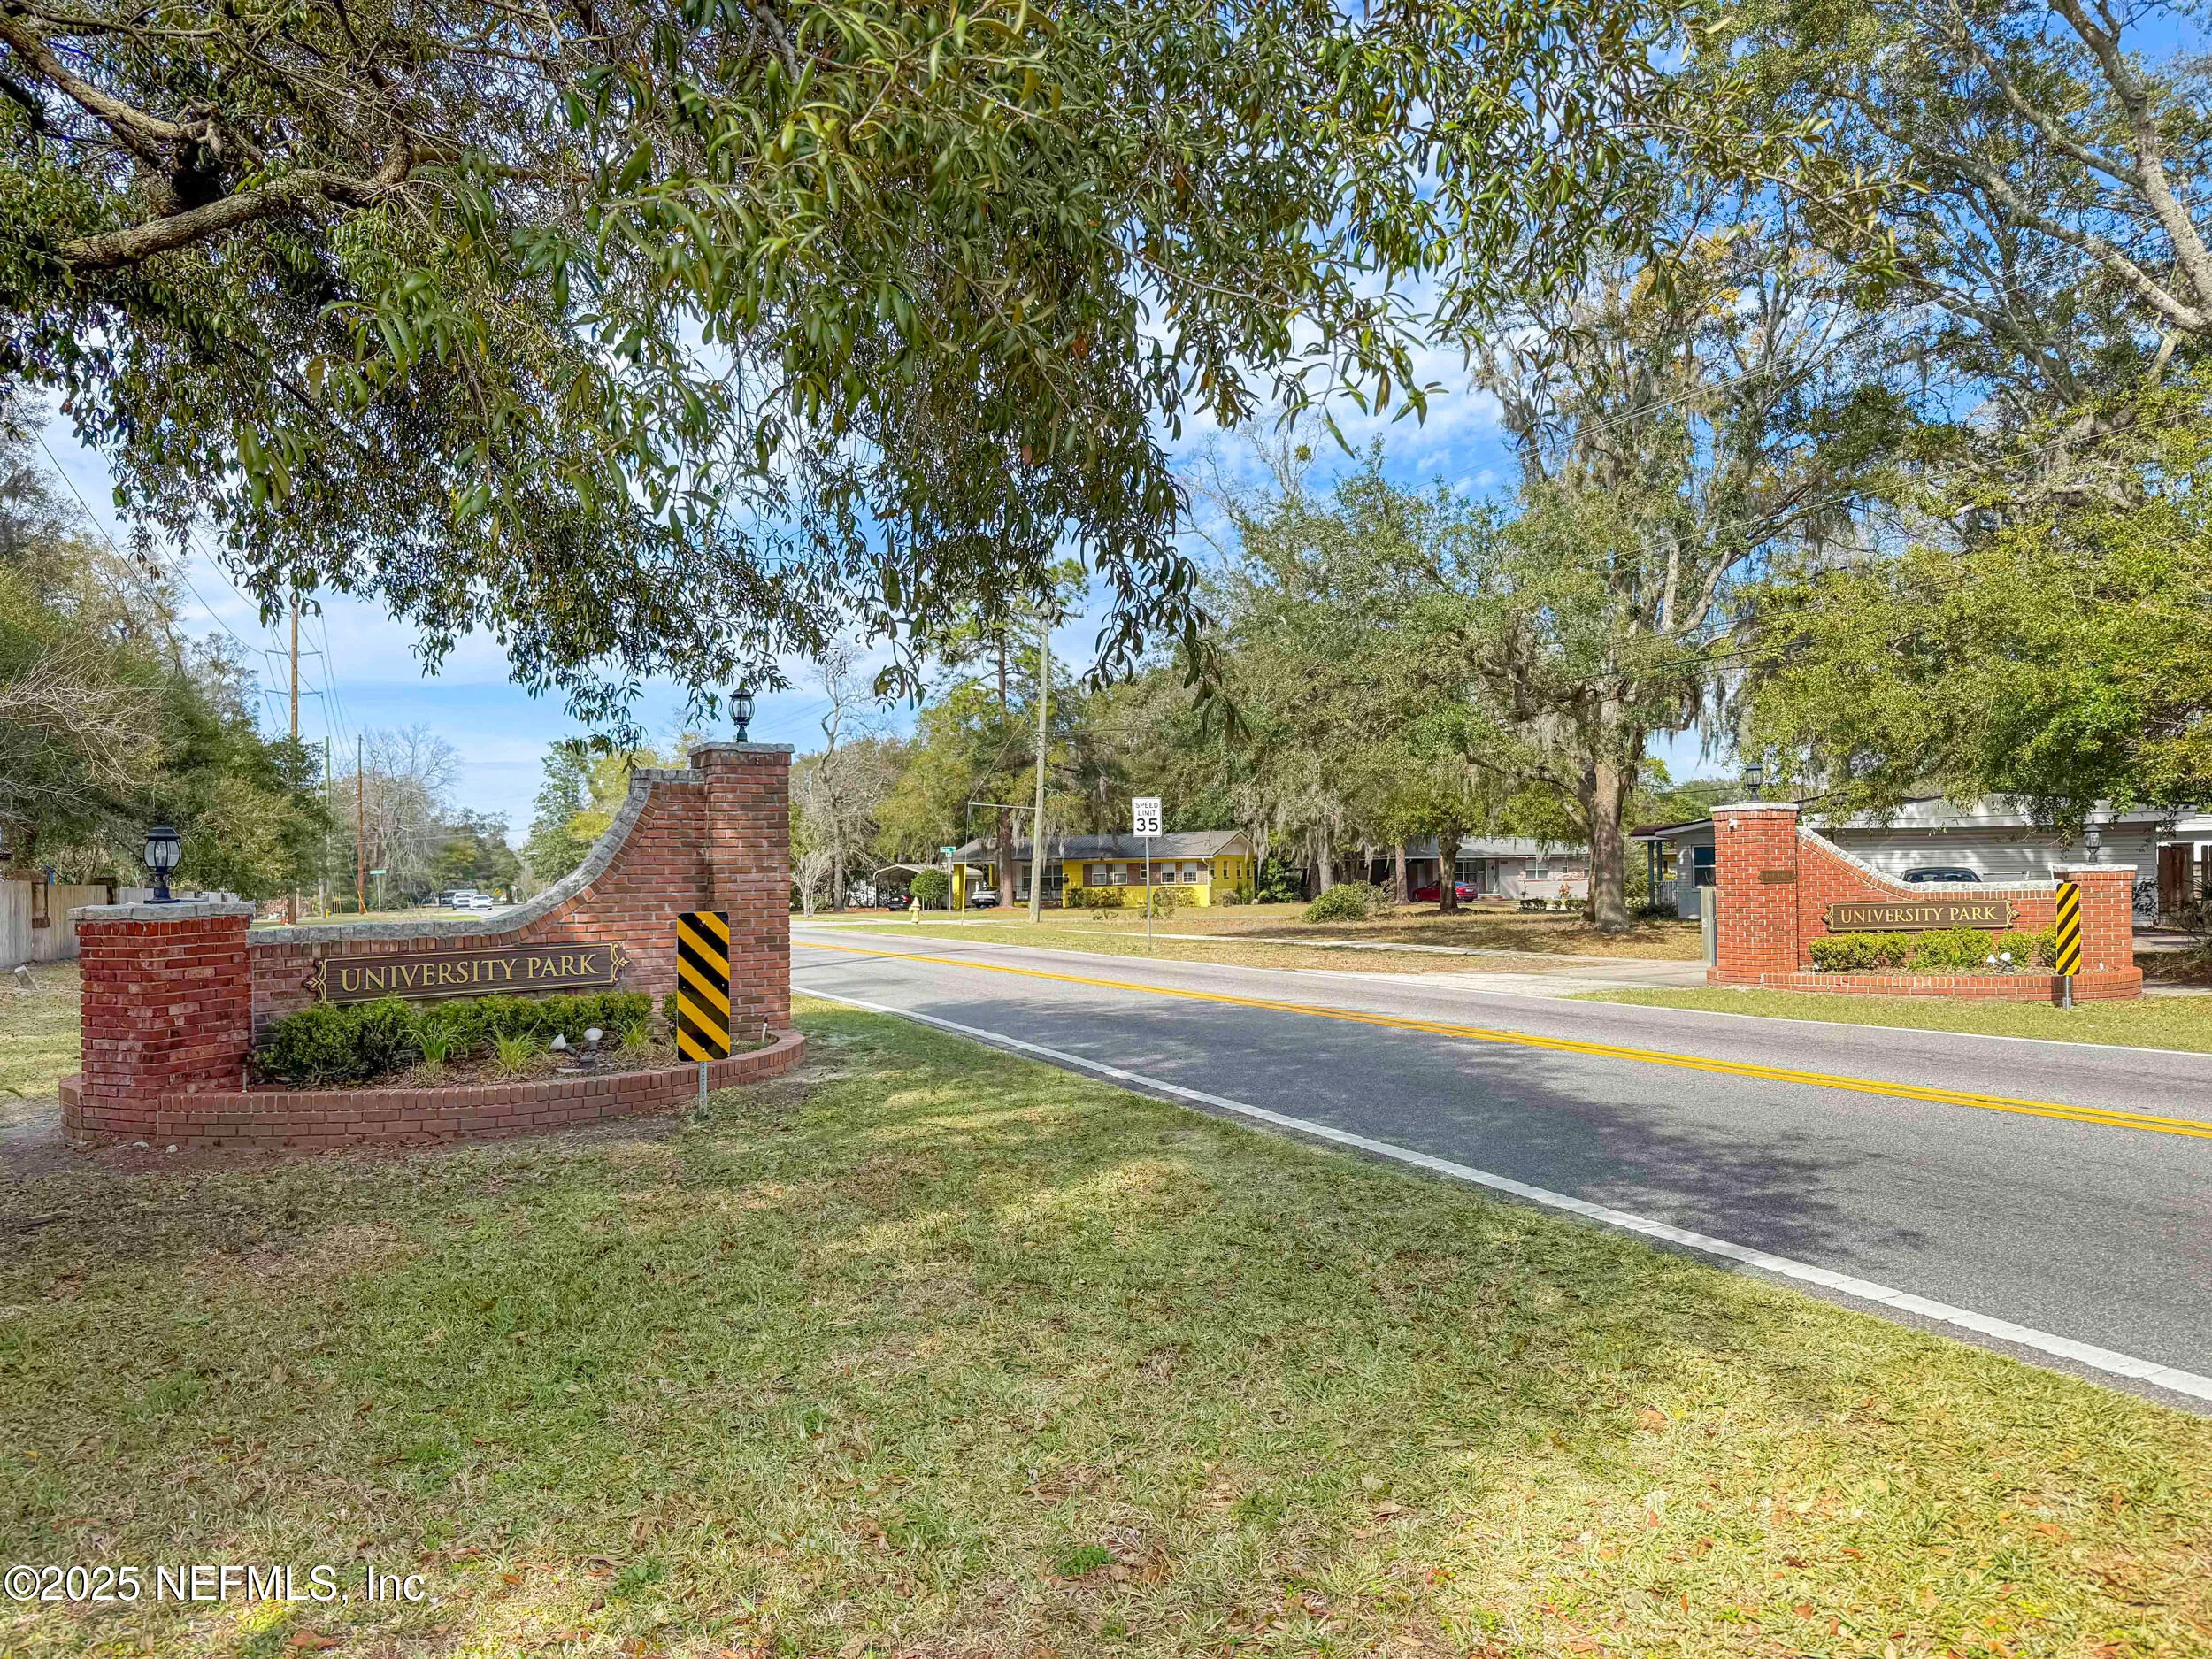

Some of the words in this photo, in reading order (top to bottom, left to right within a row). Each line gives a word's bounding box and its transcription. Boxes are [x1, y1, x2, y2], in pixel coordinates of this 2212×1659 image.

[1136, 818, 1158, 832] 35
[1840, 907, 1944, 924] UNIVERSITY
[1949, 906, 1998, 921] PARK
[340, 958, 518, 992] UNIVERSITY
[525, 954, 601, 979] PARK
